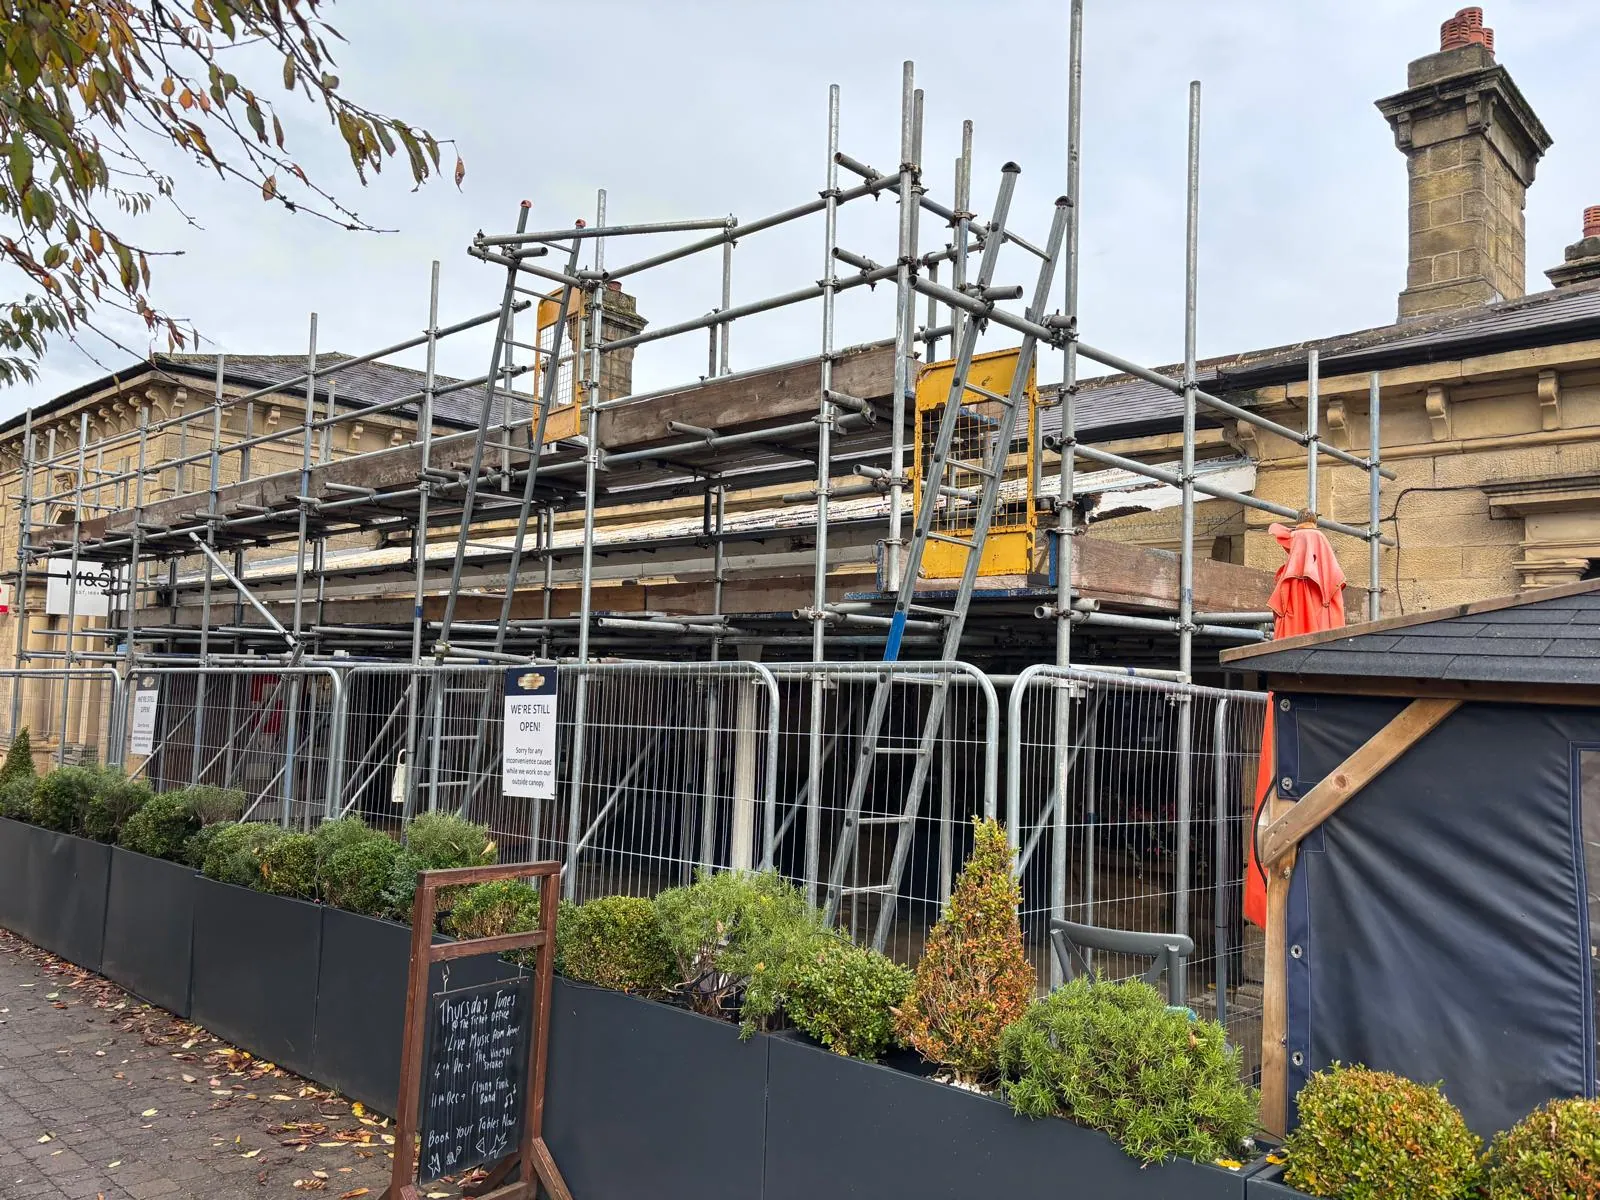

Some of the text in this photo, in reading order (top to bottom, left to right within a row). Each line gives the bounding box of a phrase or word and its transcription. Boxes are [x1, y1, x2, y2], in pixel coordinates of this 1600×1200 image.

[511, 704, 550, 714] WE'RE STILL
[520, 721, 540, 732] OPEN!
[515, 747, 527, 755] Sorry
[535, 748, 543, 756] any
[440, 995, 488, 1026] Thursday
[469, 1031, 490, 1050] Music
[453, 1058, 464, 1074] Dec
[479, 1115, 499, 1132] Tables
